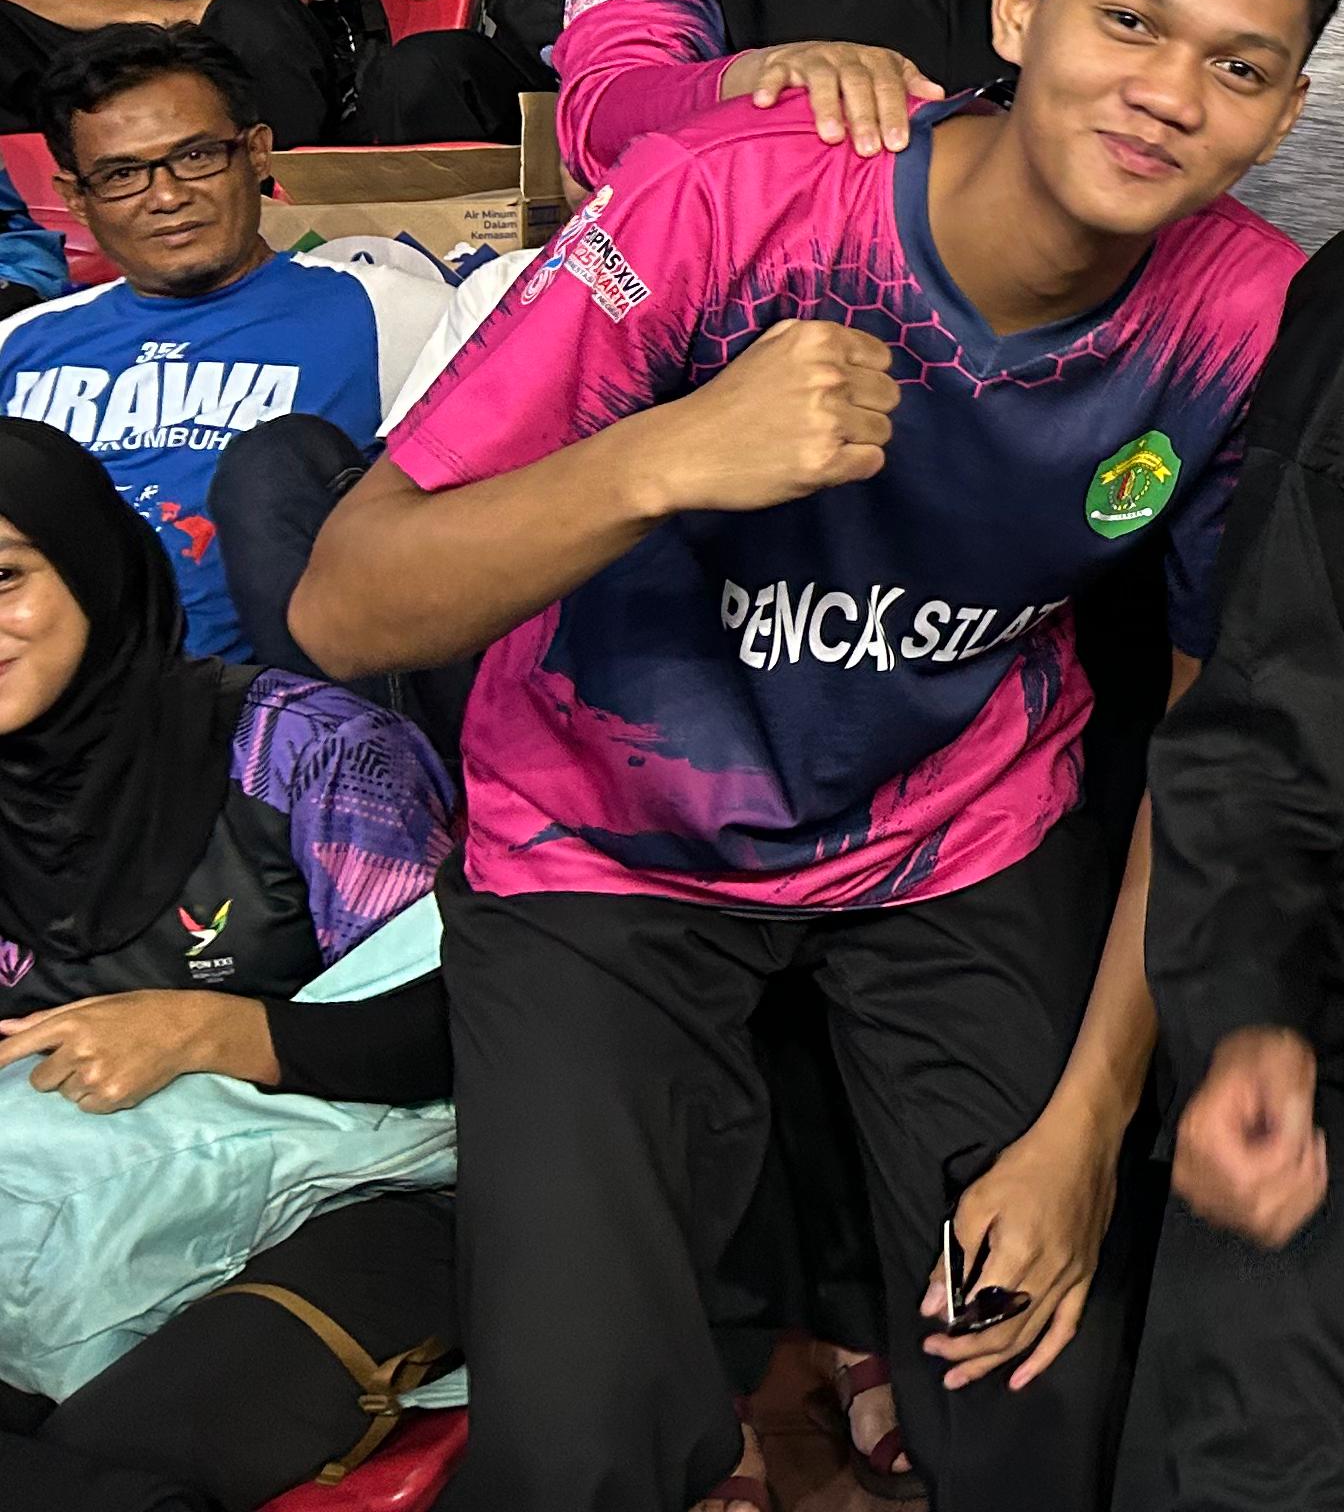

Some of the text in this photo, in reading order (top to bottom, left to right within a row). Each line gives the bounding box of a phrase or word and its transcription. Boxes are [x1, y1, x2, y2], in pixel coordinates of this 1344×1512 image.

[482, 210, 517, 219] Minum
[483, 220, 518, 230] Dalam
[471, 231, 518, 240] Kemasan
[720, 578, 906, 672] PENCAK
